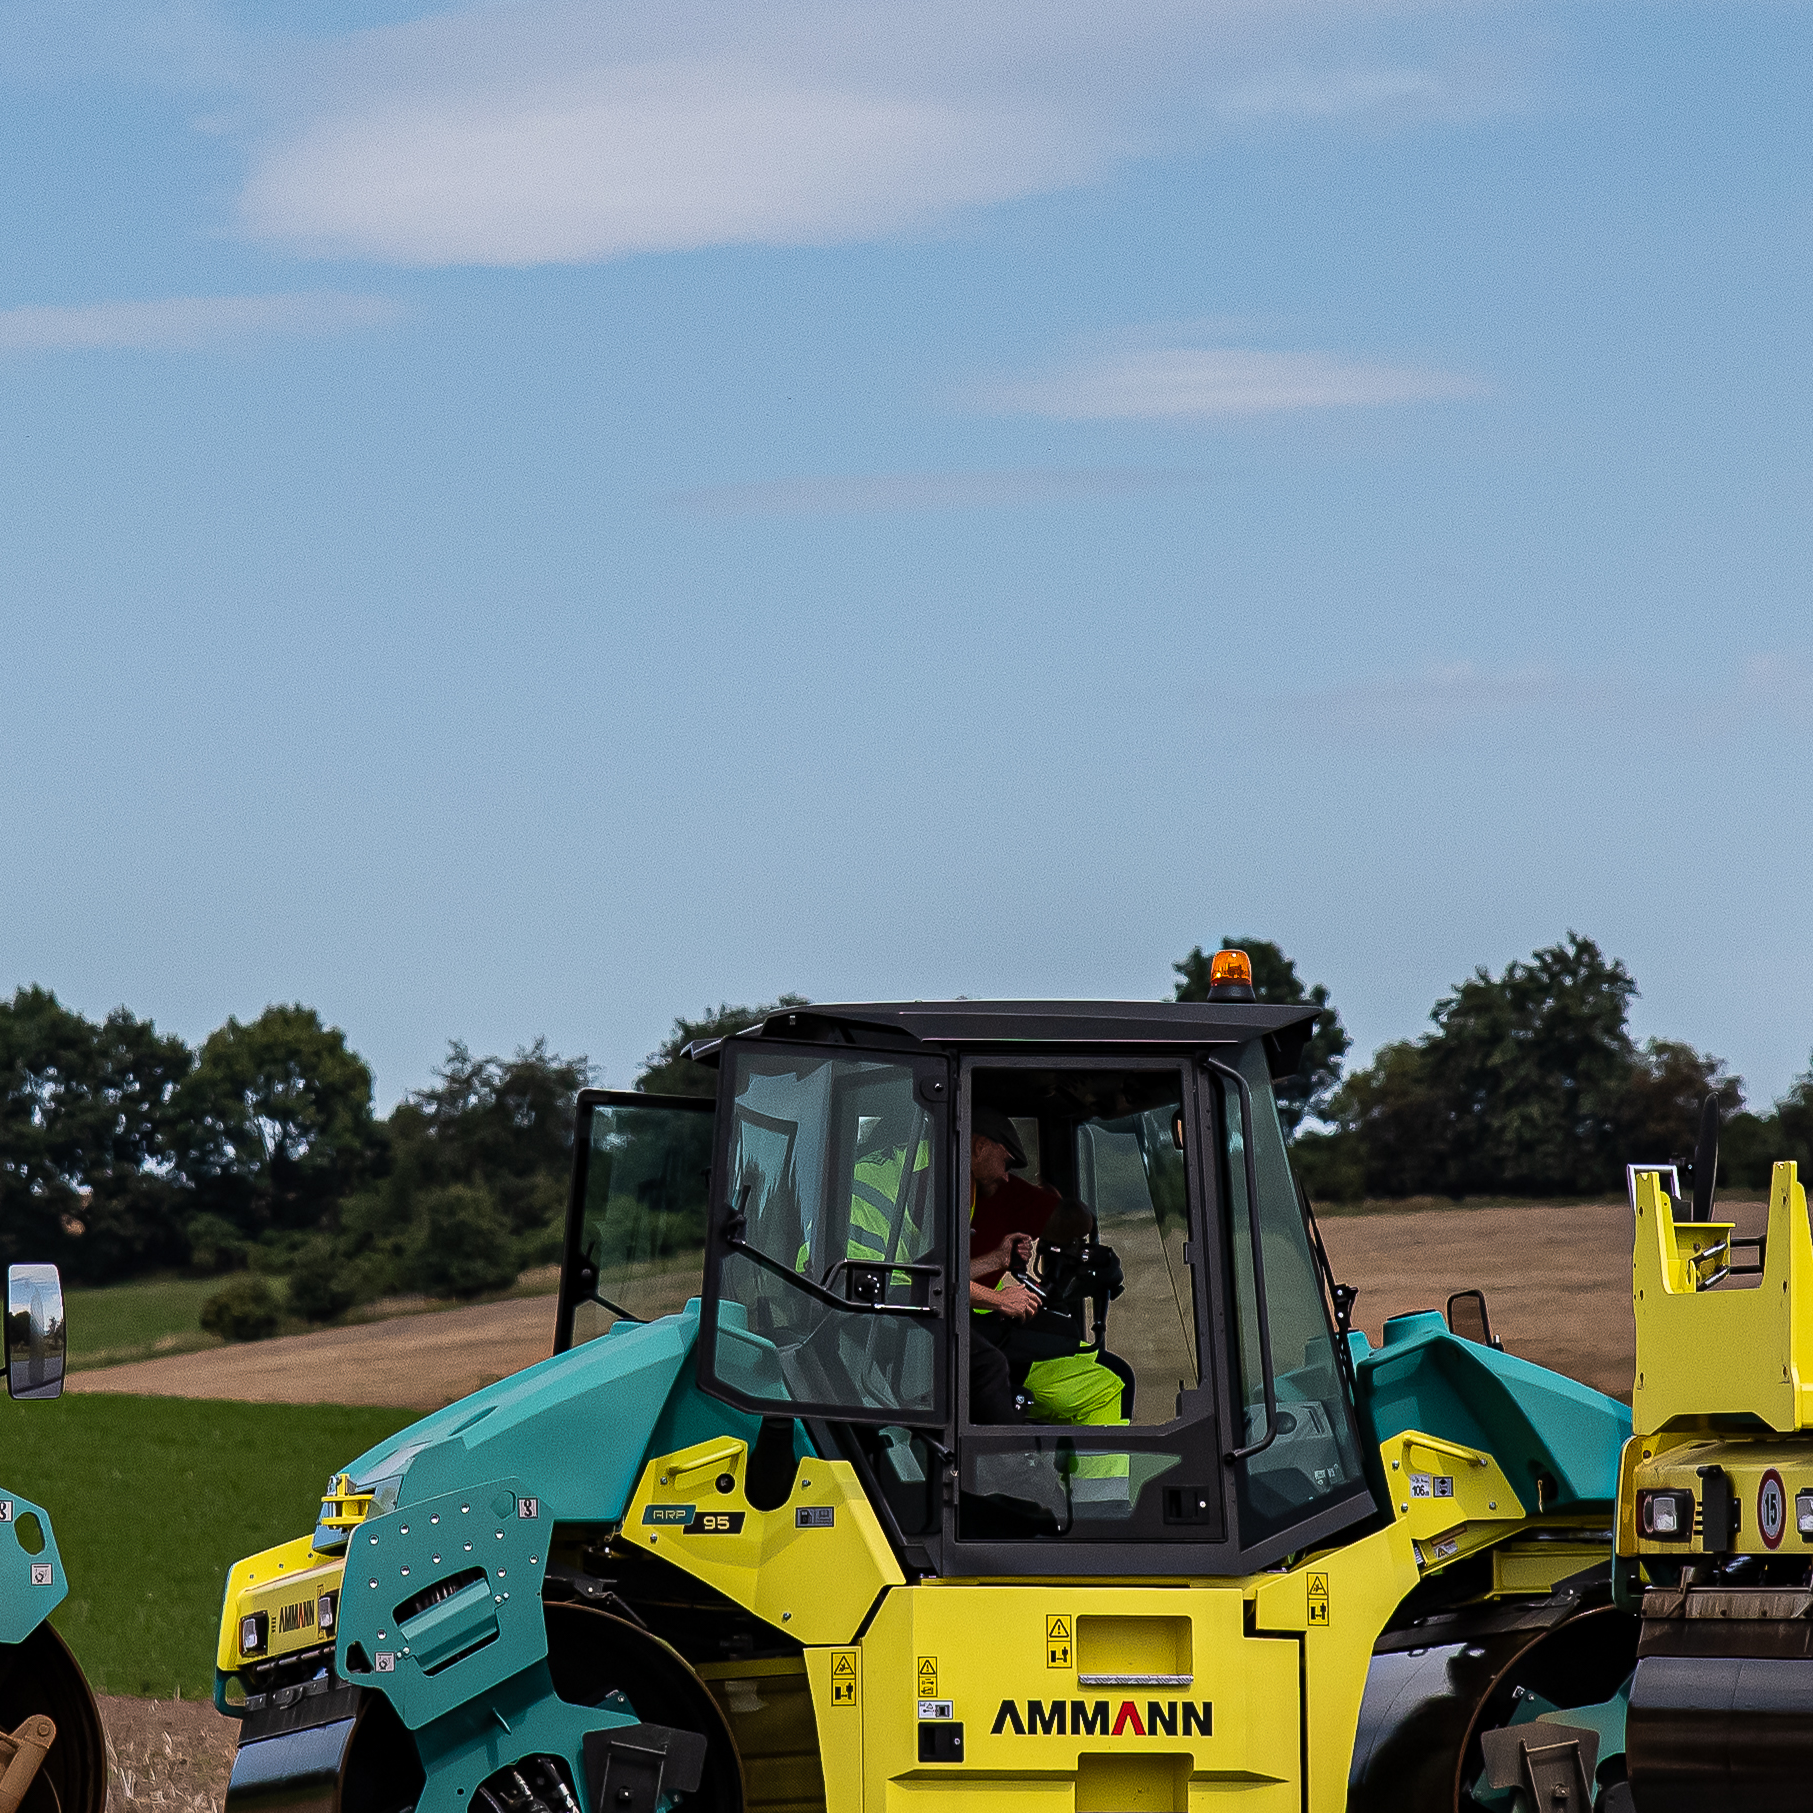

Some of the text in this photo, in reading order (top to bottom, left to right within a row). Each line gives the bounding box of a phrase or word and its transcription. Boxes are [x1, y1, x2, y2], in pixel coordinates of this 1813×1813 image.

[1412, 1485, 1425, 1497] 106
[653, 1510, 686, 1520] ARP
[1765, 1493, 1778, 1526] 15
[703, 1516, 730, 1530] 95
[990, 1699, 1213, 1737] AMMANN
